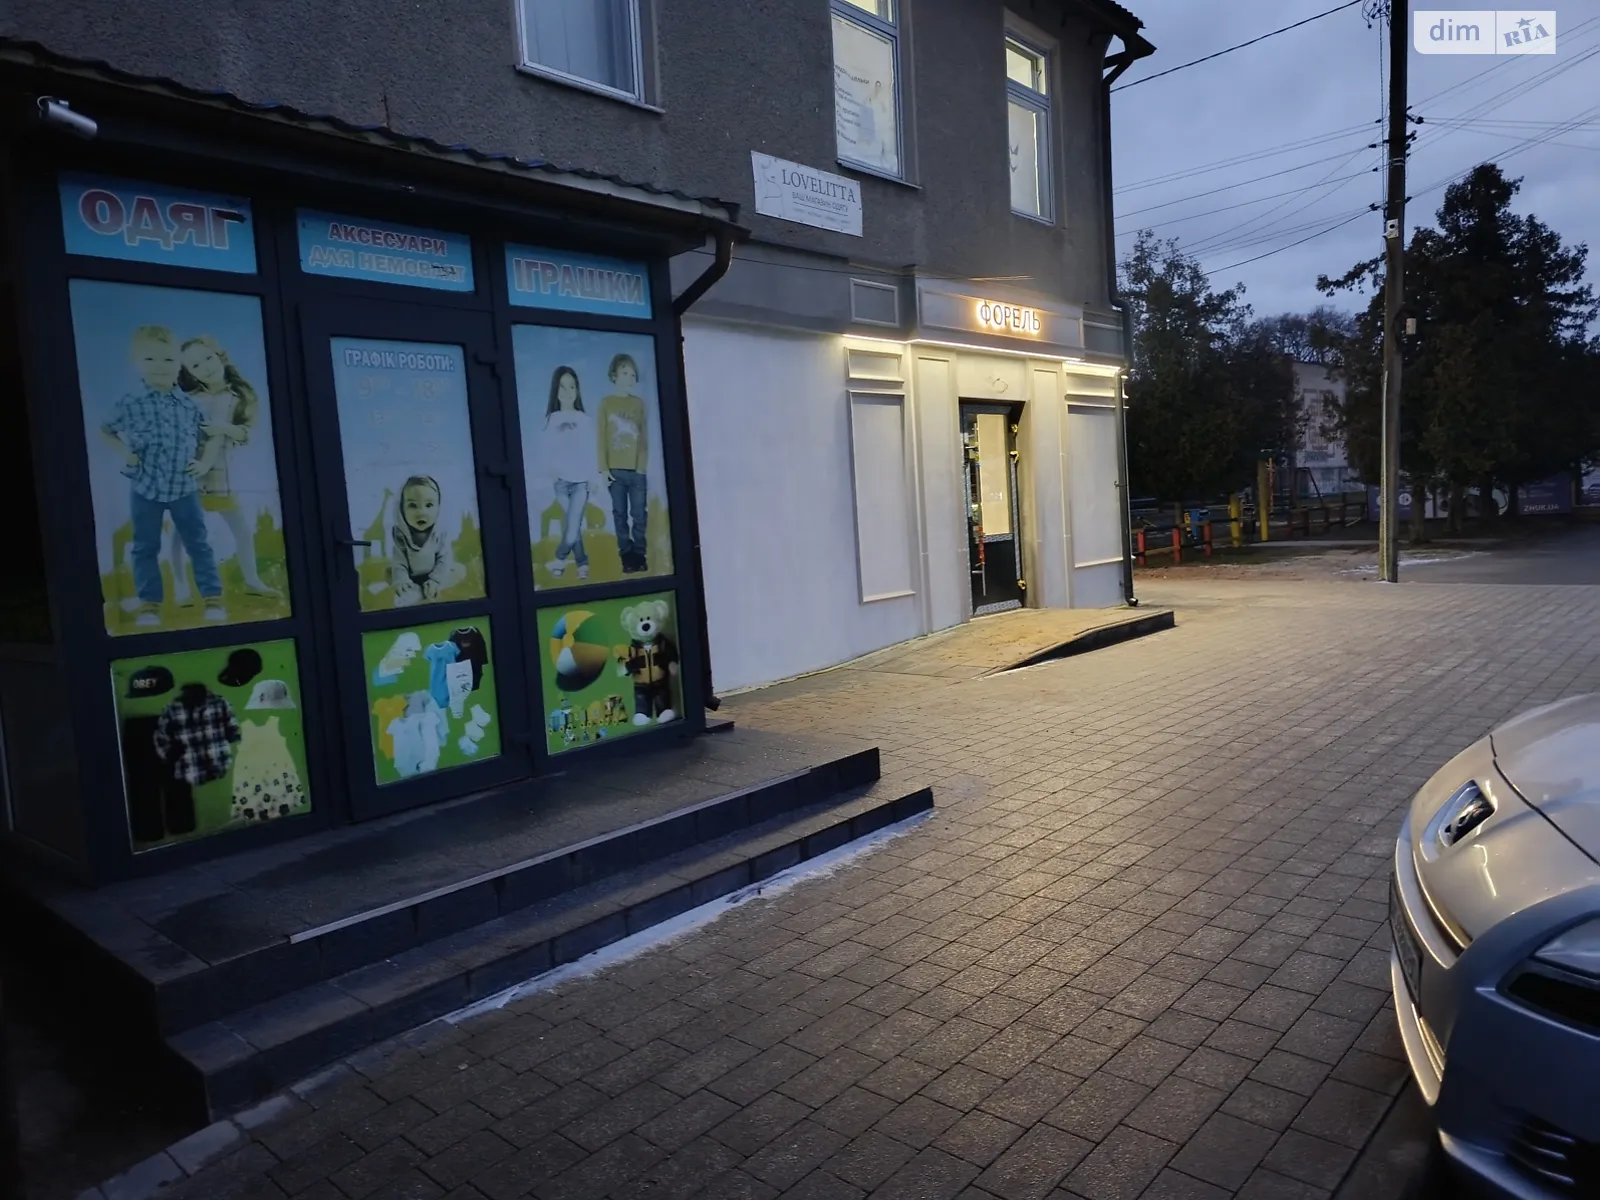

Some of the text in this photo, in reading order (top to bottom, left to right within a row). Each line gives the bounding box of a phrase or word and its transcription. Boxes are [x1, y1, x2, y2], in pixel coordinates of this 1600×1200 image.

[781, 169, 857, 204] LOVELITTA
[78, 188, 244, 251] ОДЯГ
[309, 245, 355, 269] ДЛЯ
[328, 222, 448, 257] АКСЕСУАРИ
[512, 257, 645, 306] ІГРАШКИ
[979, 299, 1041, 331] ФОРЕЛЬ
[343, 348, 456, 373] ГРАФІК РОБОТИ:
